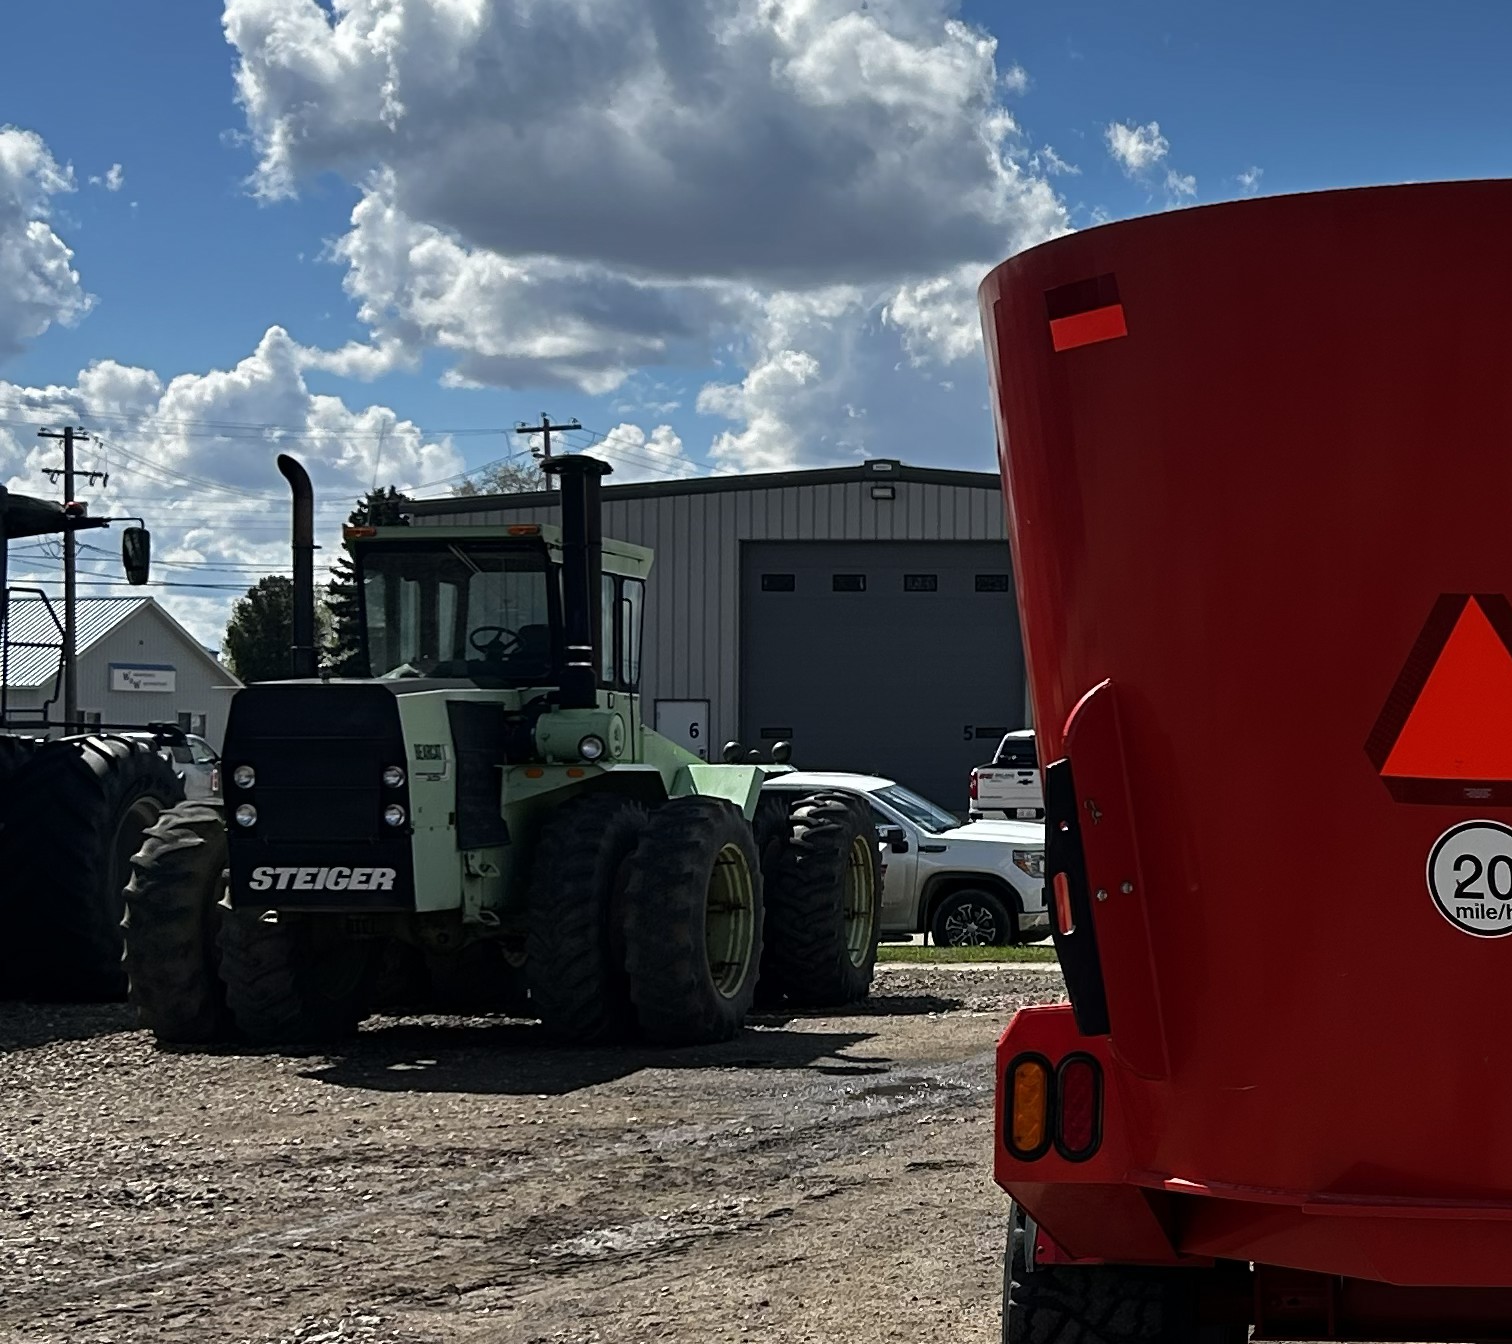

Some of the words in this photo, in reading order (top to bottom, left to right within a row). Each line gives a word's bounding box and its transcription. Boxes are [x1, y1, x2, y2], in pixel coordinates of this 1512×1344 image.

[689, 722, 700, 739] 6
[963, 725, 974, 741] 5
[249, 866, 397, 891] STEIGER
